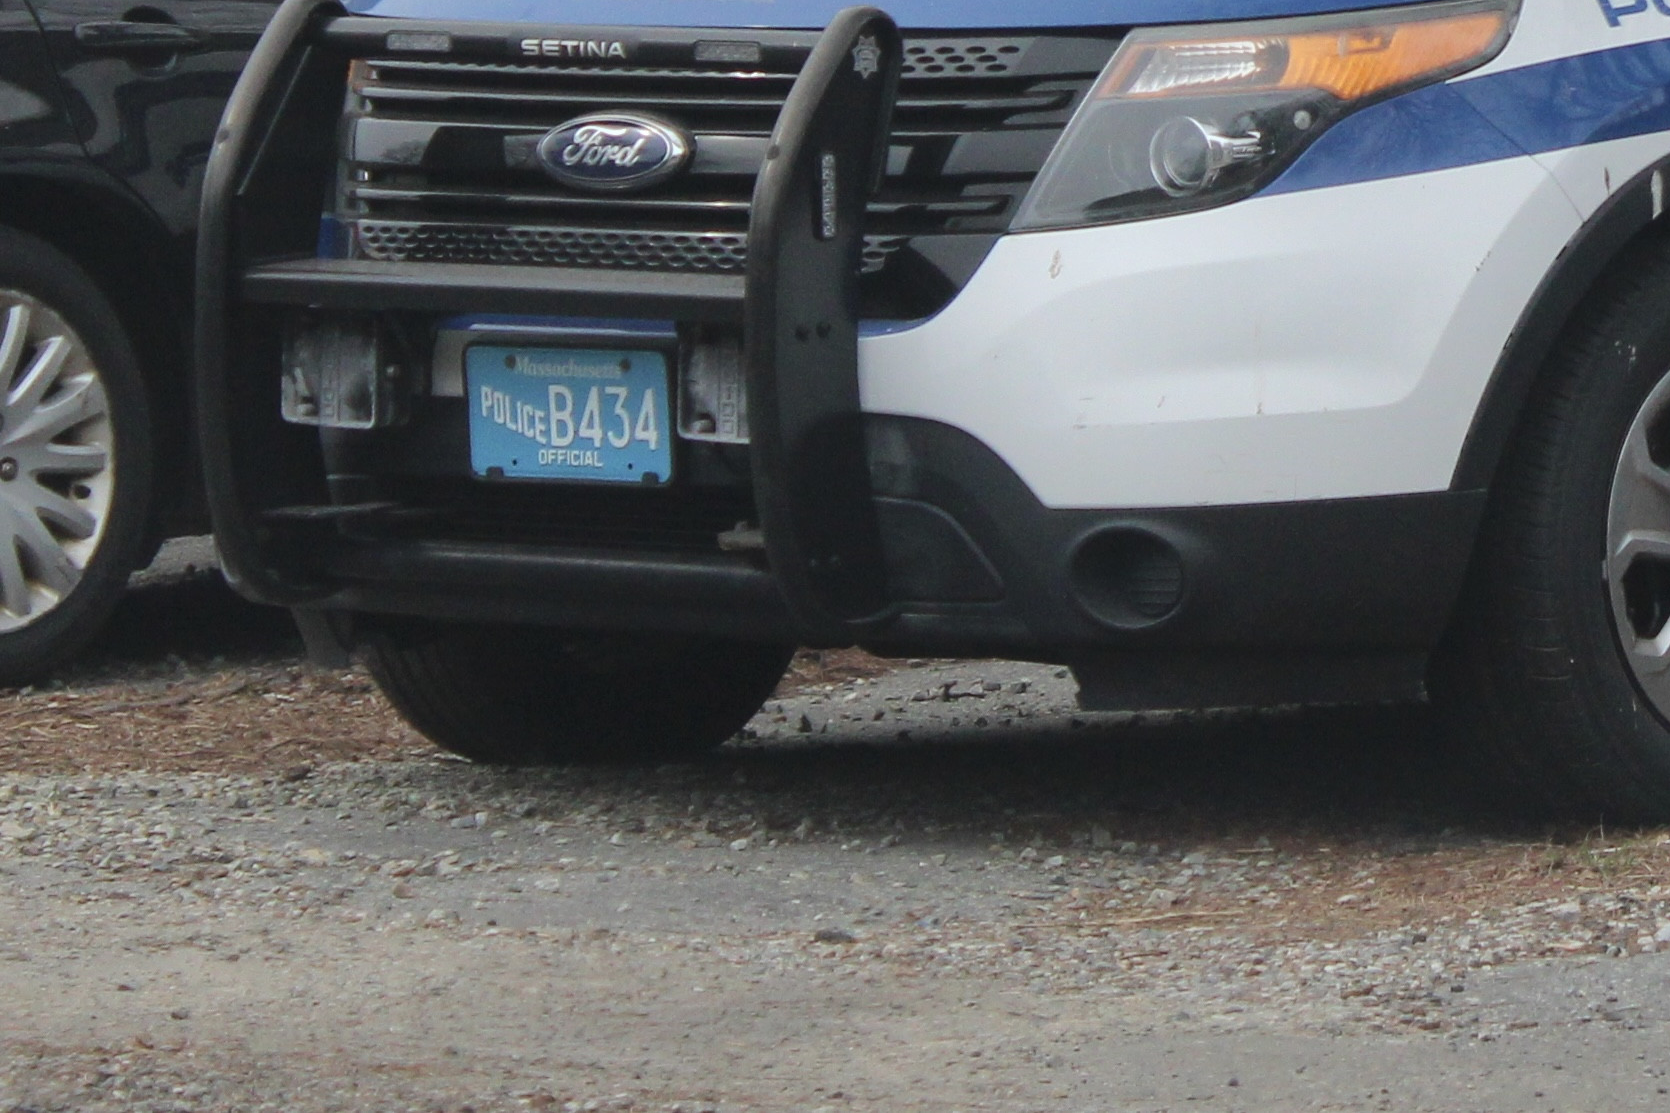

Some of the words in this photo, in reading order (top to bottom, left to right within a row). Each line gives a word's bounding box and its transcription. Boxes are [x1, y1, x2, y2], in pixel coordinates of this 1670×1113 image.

[521, 39, 627, 58] SETINA
[562, 125, 646, 167] Ford
[515, 355, 623, 379] Massachusetts
[481, 385, 547, 445] POLICE
[548, 384, 660, 451] B434
[538, 449, 604, 467] OFFICIAL
